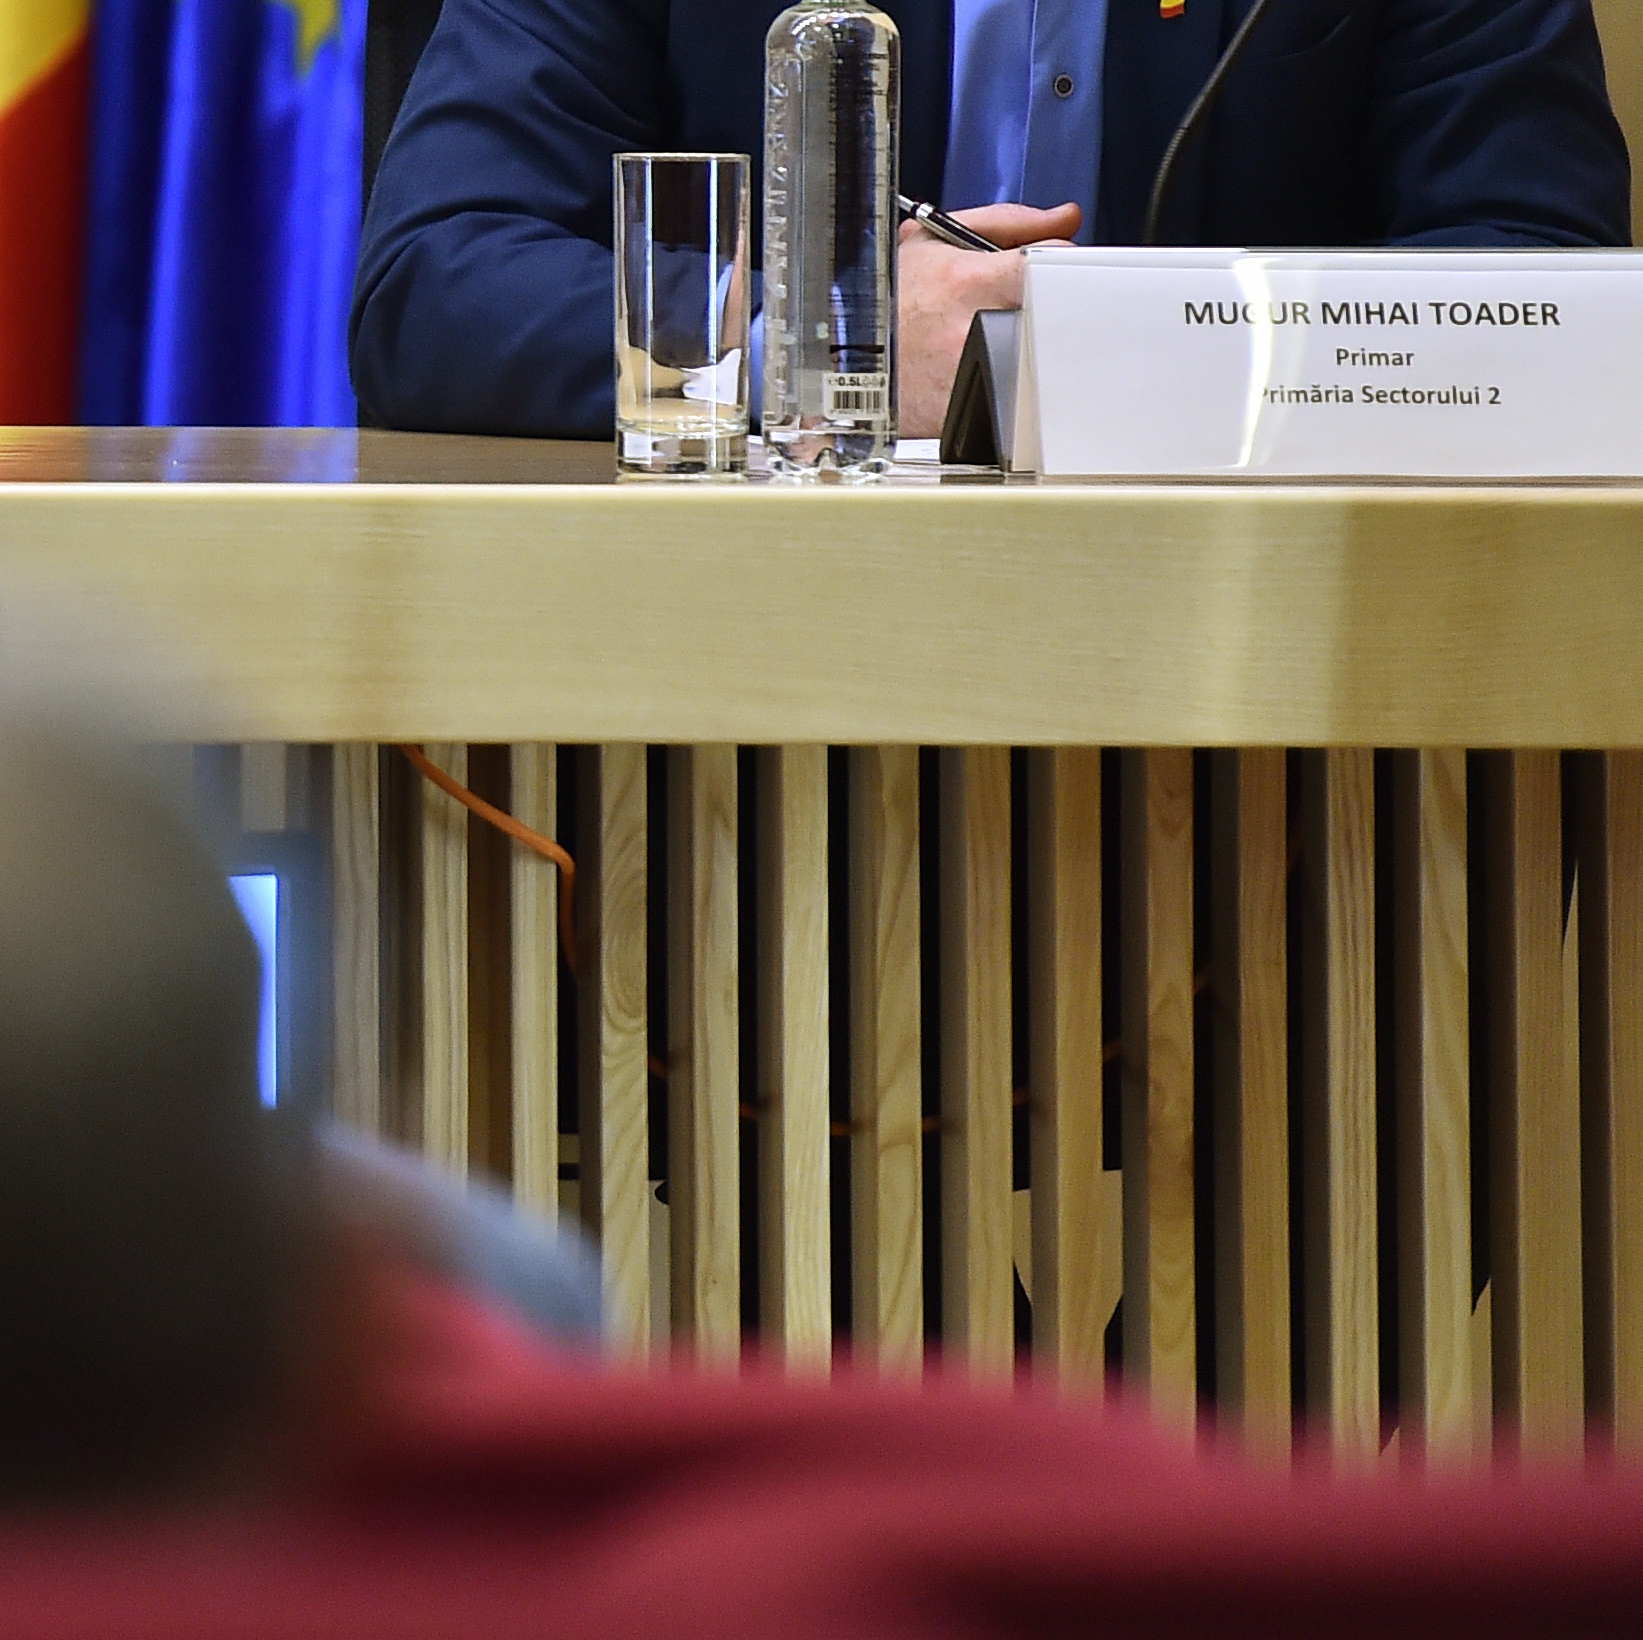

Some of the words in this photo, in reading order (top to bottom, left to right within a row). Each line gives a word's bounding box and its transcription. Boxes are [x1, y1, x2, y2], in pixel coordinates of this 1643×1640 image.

[1321, 301, 1419, 327] MIHAI
[1428, 302, 1562, 327] TOADER
[1335, 347, 1415, 367] Primar
[1263, 384, 1355, 405] rimăria
[1361, 384, 1481, 406] Sectorului
[1488, 386, 1502, 405] 2
